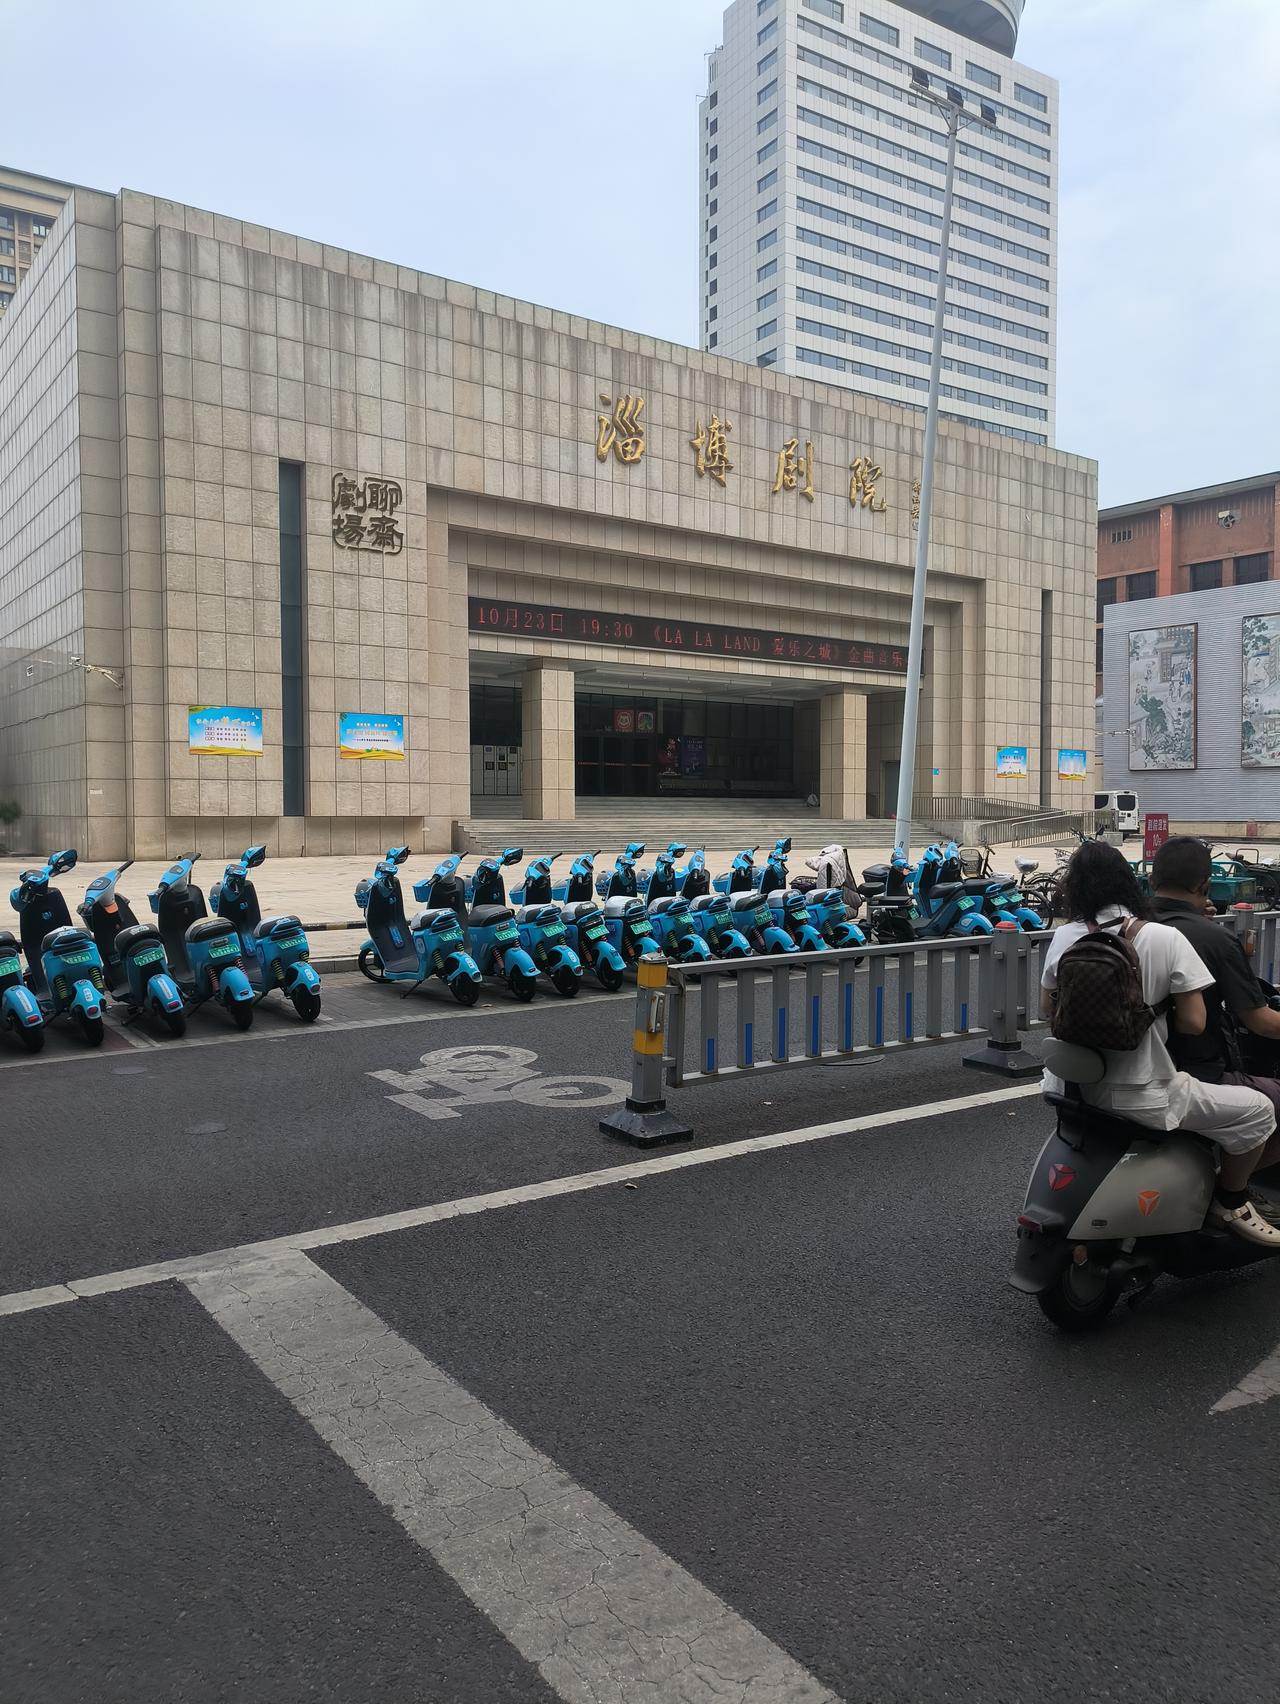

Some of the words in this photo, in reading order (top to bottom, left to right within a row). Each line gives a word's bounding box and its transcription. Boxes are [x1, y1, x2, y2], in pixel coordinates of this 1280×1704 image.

[581, 618, 634, 639] 19:30
[694, 630, 713, 647] LA
[723, 633, 761, 652] LAND
